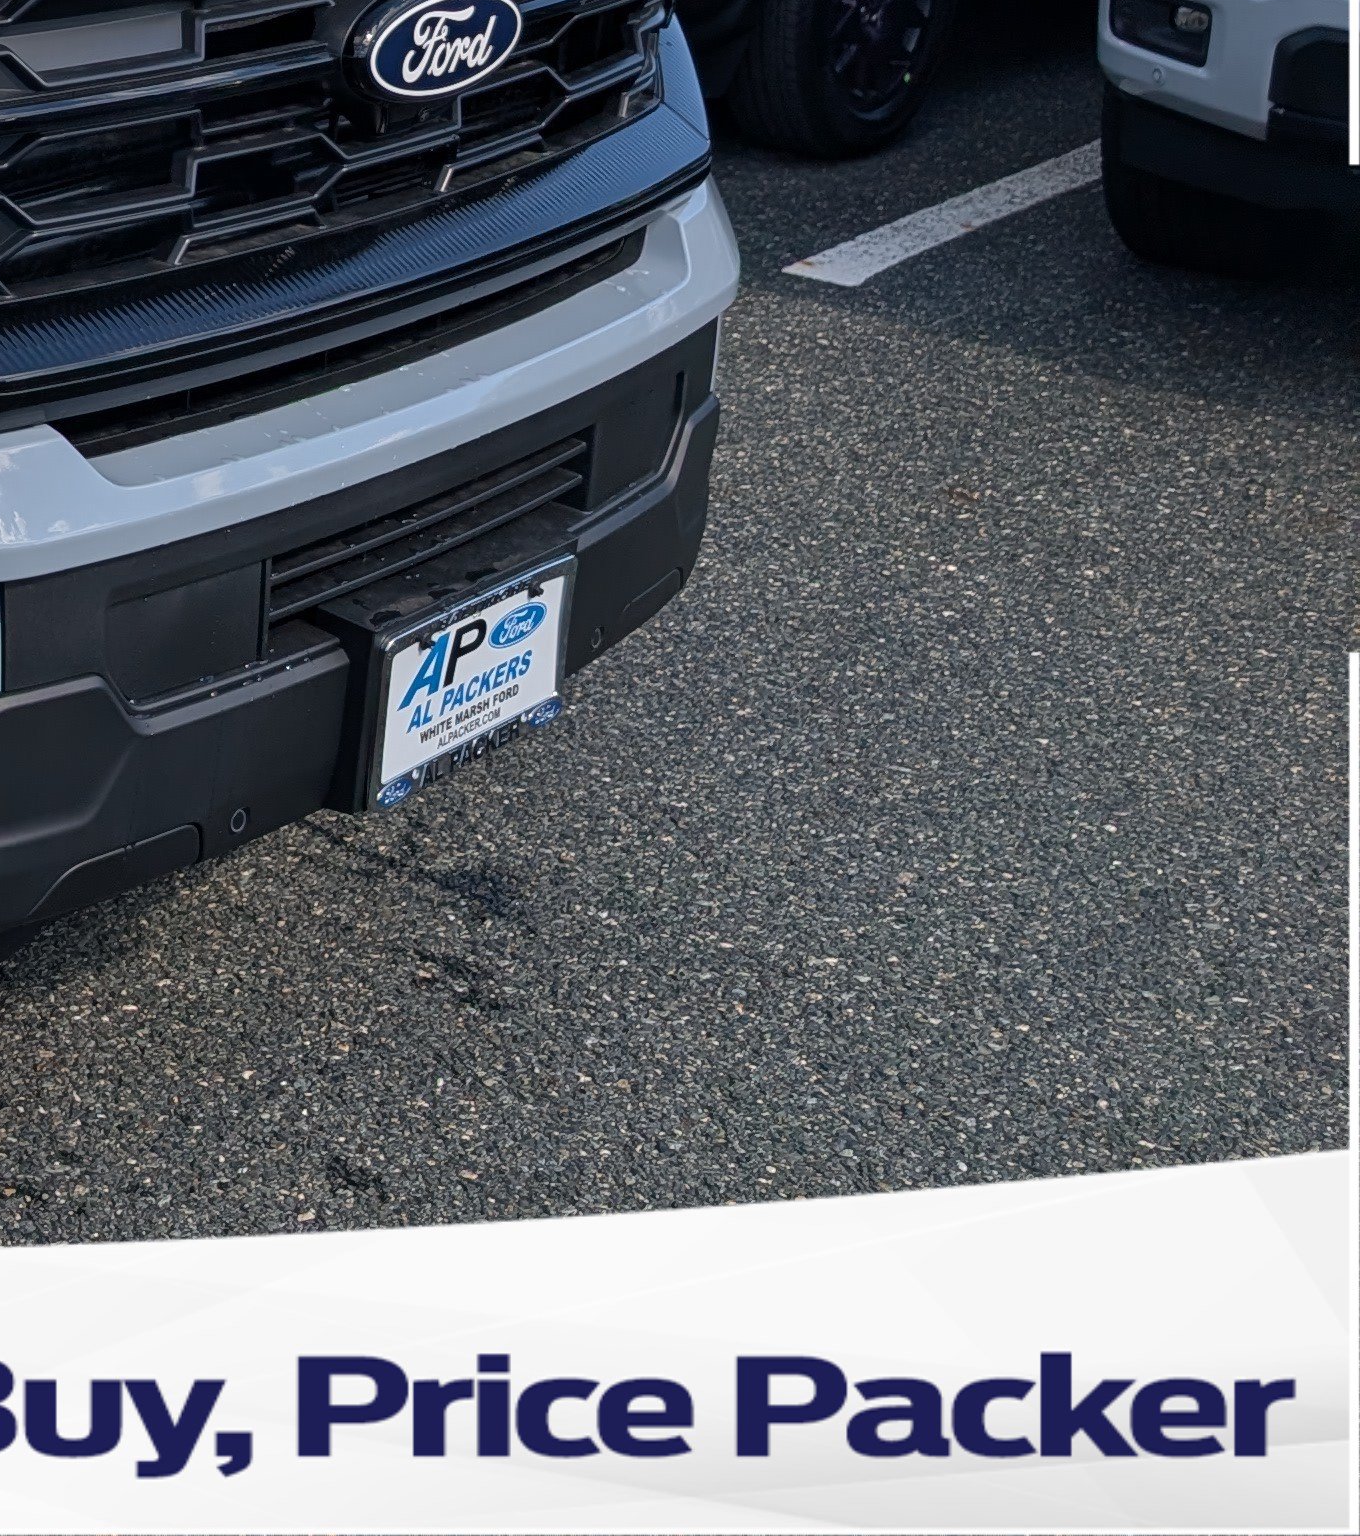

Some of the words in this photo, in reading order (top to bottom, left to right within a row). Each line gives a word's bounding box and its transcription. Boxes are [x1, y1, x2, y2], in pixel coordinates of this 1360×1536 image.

[402, 5, 497, 84] Ford
[498, 608, 537, 645] Ford
[396, 617, 488, 711] AP
[406, 699, 433, 735] AL
[440, 649, 534, 718] PACKERS
[419, 716, 453, 745] WHITE
[454, 698, 491, 726] MARSH
[492, 683, 520, 710] FORD
[436, 707, 502, 750] ALPACKER.COM
[418, 758, 445, 789] AL
[449, 720, 521, 770] PACKER
